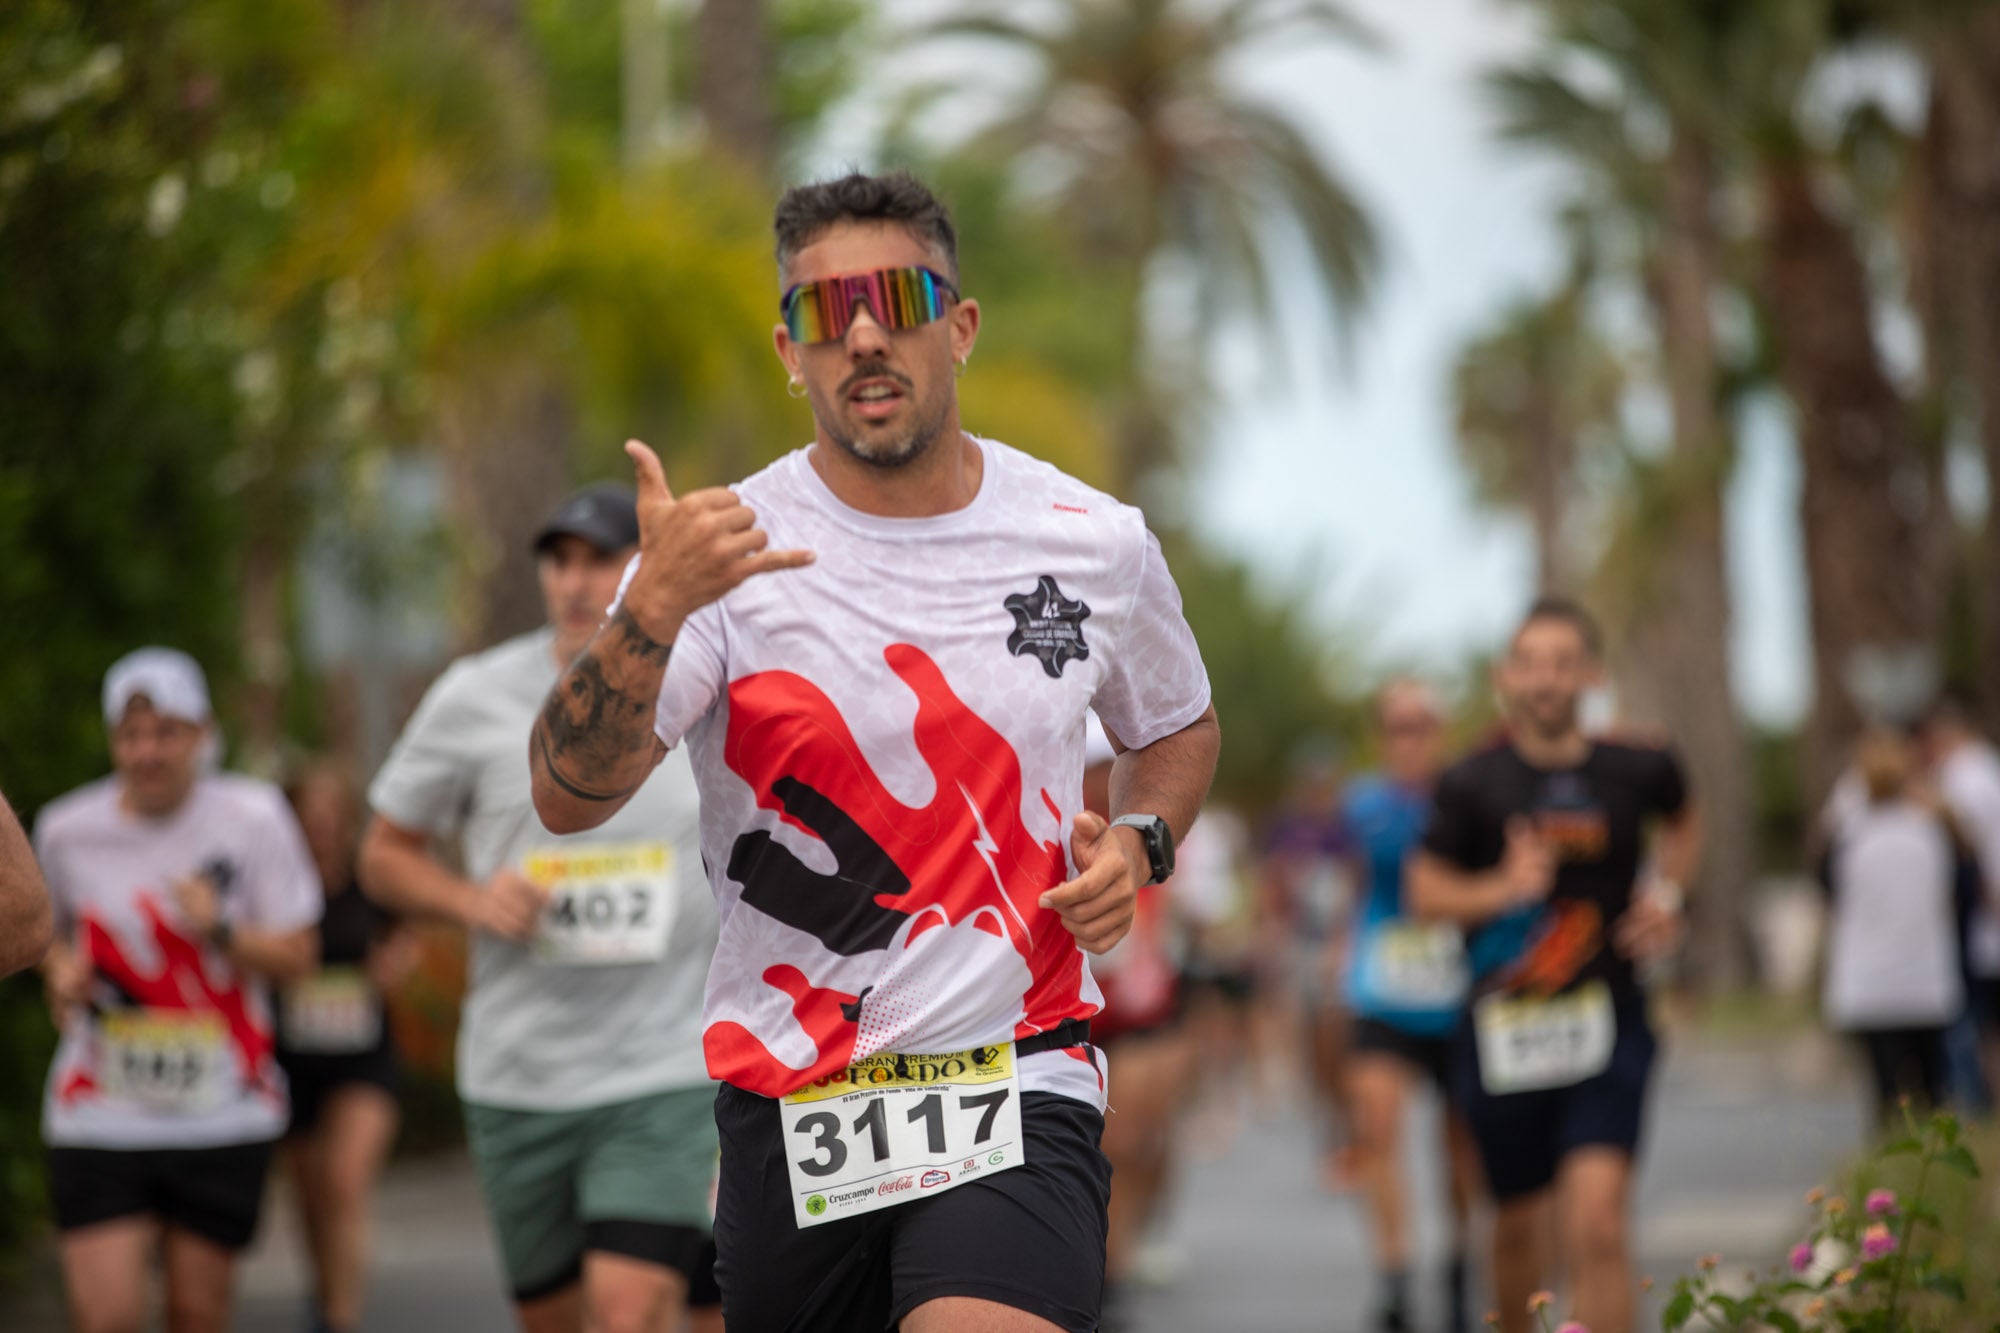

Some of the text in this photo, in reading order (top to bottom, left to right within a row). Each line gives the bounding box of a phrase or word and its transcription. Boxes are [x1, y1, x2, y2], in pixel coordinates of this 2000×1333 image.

[855, 1056, 896, 1067] GRAN
[860, 1090, 877, 1098] Premio
[794, 1087, 1009, 1178] 3117
[829, 1186, 875, 1204] Cruzcampo
